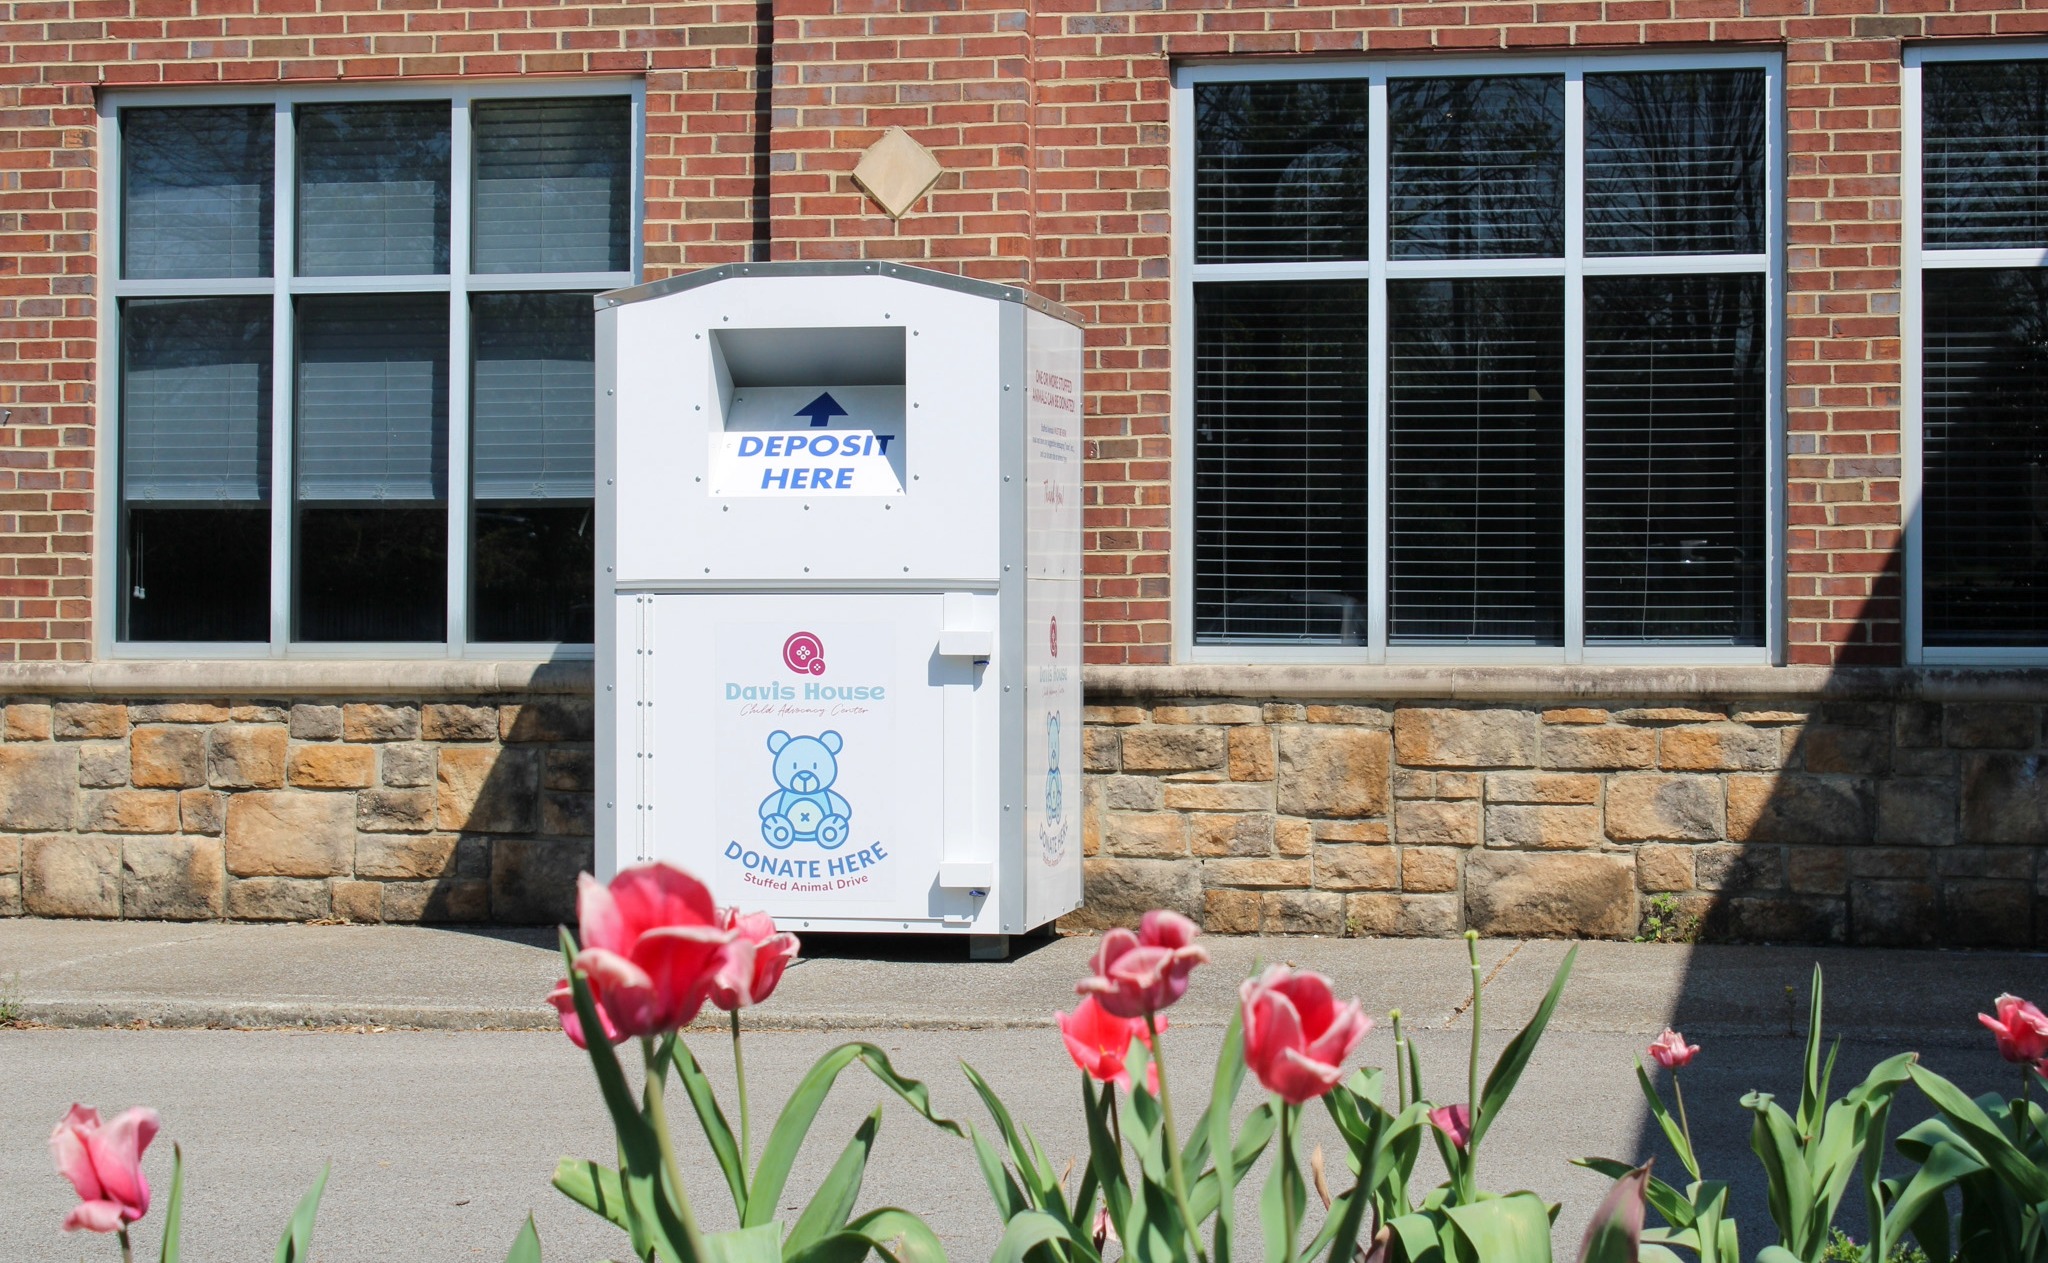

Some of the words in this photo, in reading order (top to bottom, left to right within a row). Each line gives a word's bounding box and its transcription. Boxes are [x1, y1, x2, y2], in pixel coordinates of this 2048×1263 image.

[738, 435, 895, 457] DEPOSIT
[761, 467, 855, 489] HERE
[726, 681, 795, 701] Davis
[804, 682, 885, 701] House
[740, 703, 775, 717] Child
[777, 703, 825, 718] Advocacy
[831, 703, 869, 717] Center
[724, 840, 821, 878] DONATE
[827, 840, 888, 877] HERE
[743, 872, 787, 891] Stuffed
[791, 881, 833, 892] Animal
[837, 874, 869, 889] Drive
